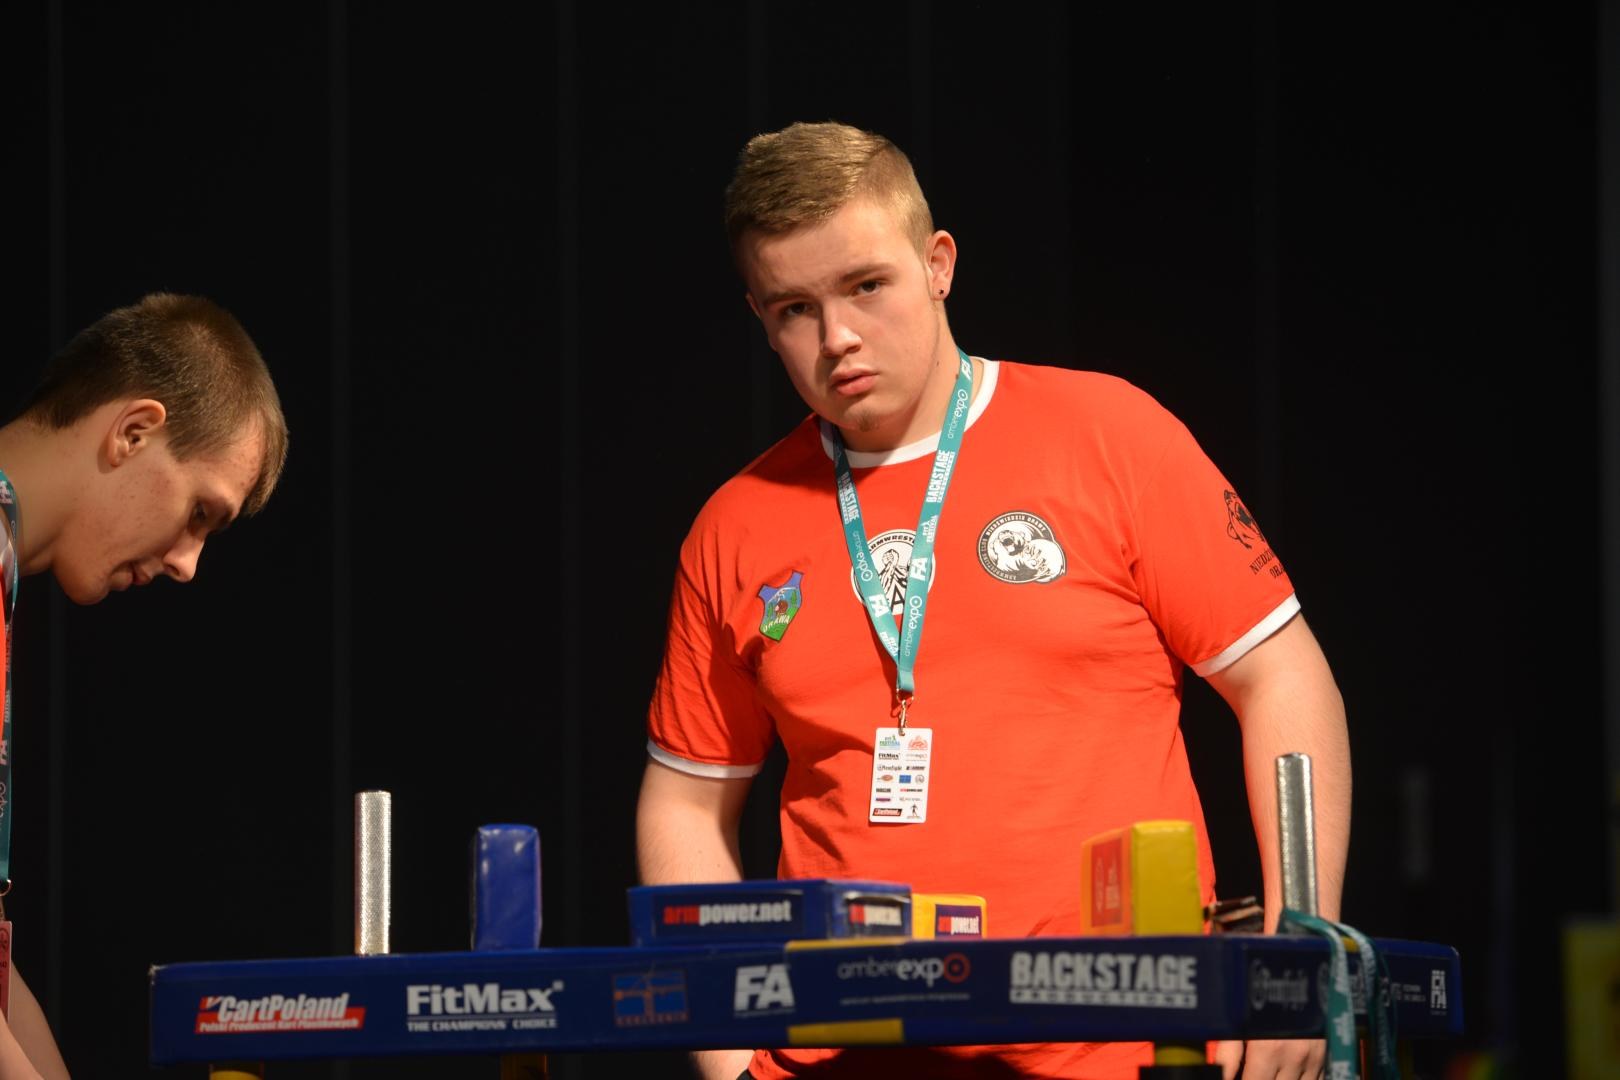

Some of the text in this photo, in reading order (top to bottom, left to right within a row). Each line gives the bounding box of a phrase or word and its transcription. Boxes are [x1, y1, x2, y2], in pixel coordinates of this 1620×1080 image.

[926, 450, 950, 503] BACKSTAGE
[910, 557, 928, 581] FA
[868, 593, 890, 618] FA
[663, 900, 793, 926] armpower.net
[1010, 951, 1198, 992] BACKSTAGE
[406, 983, 556, 1015] FitMax
[734, 963, 796, 1011] FA
[407, 1021, 431, 1032] THE
[512, 1018, 557, 1029] CHOICE
